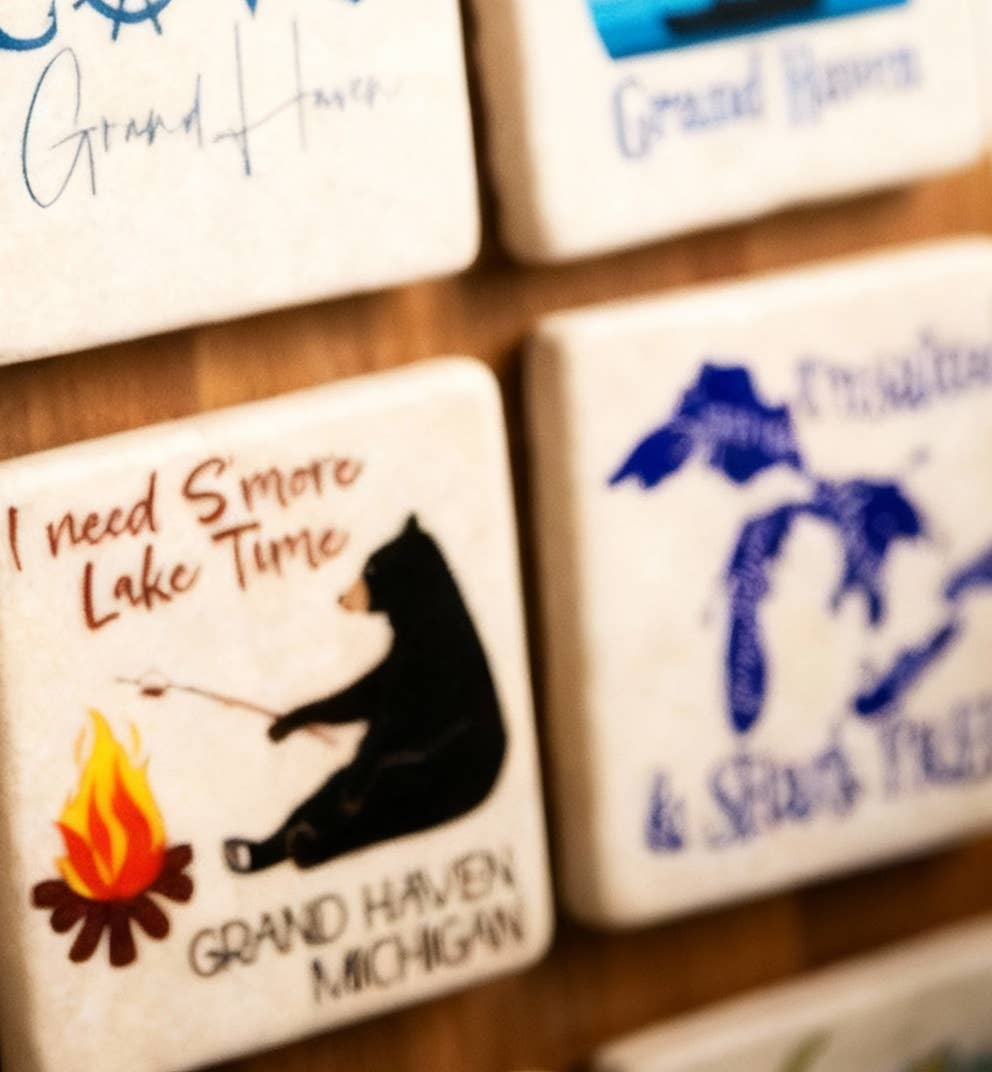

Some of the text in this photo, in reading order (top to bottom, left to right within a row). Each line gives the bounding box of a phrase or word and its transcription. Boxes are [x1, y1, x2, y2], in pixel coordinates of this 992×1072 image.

[22, 46, 203, 209] Grand
[8, 505, 23, 572] I
[45, 469, 159, 558] need
[82, 521, 351, 632] Lake Time
[187, 890, 350, 979] GRAND
[309, 898, 528, 1006] MICHIGAN
